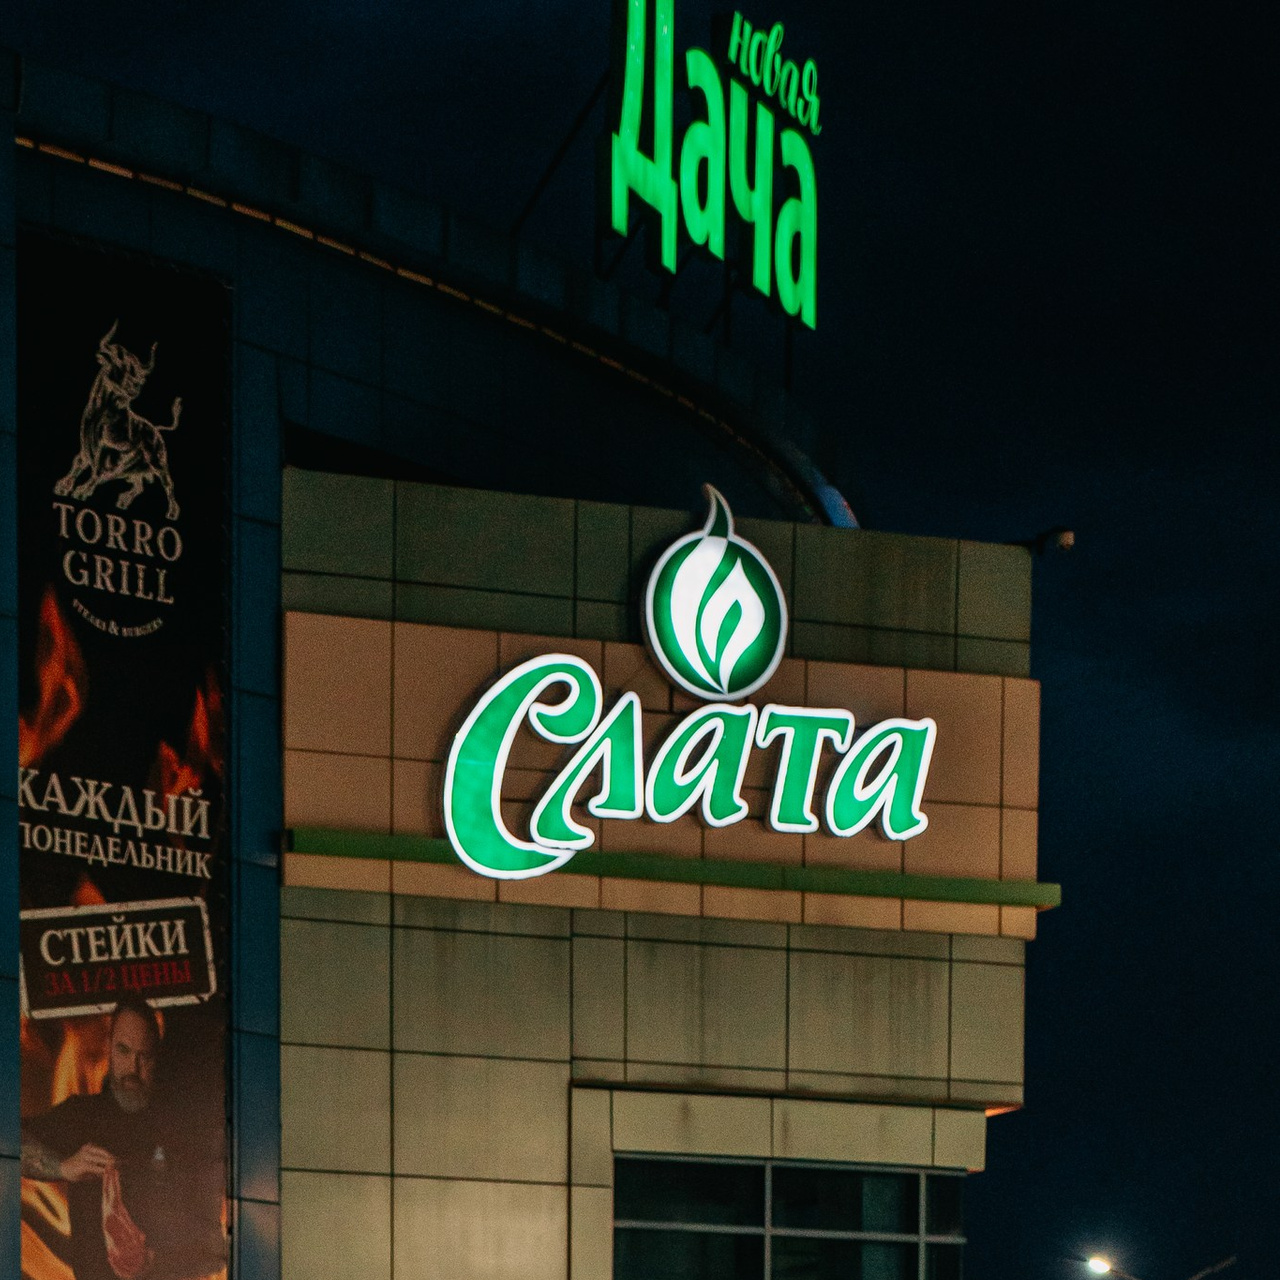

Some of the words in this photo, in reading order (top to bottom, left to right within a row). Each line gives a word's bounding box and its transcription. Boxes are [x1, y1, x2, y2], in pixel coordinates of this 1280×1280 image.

[728, 10, 822, 135] новая
[612, 0, 817, 331] Дача
[53, 501, 183, 562] TORRO
[63, 550, 174, 604] GRILL
[442, 653, 936, 881] Слата
[18, 766, 210, 839] КАЖДЫЙ
[40, 915, 189, 966] СТЕЙКИ
[45, 971, 76, 996] ЗА
[81, 967, 115, 993] 1/2
[120, 960, 192, 993] ЦЕНЫ
